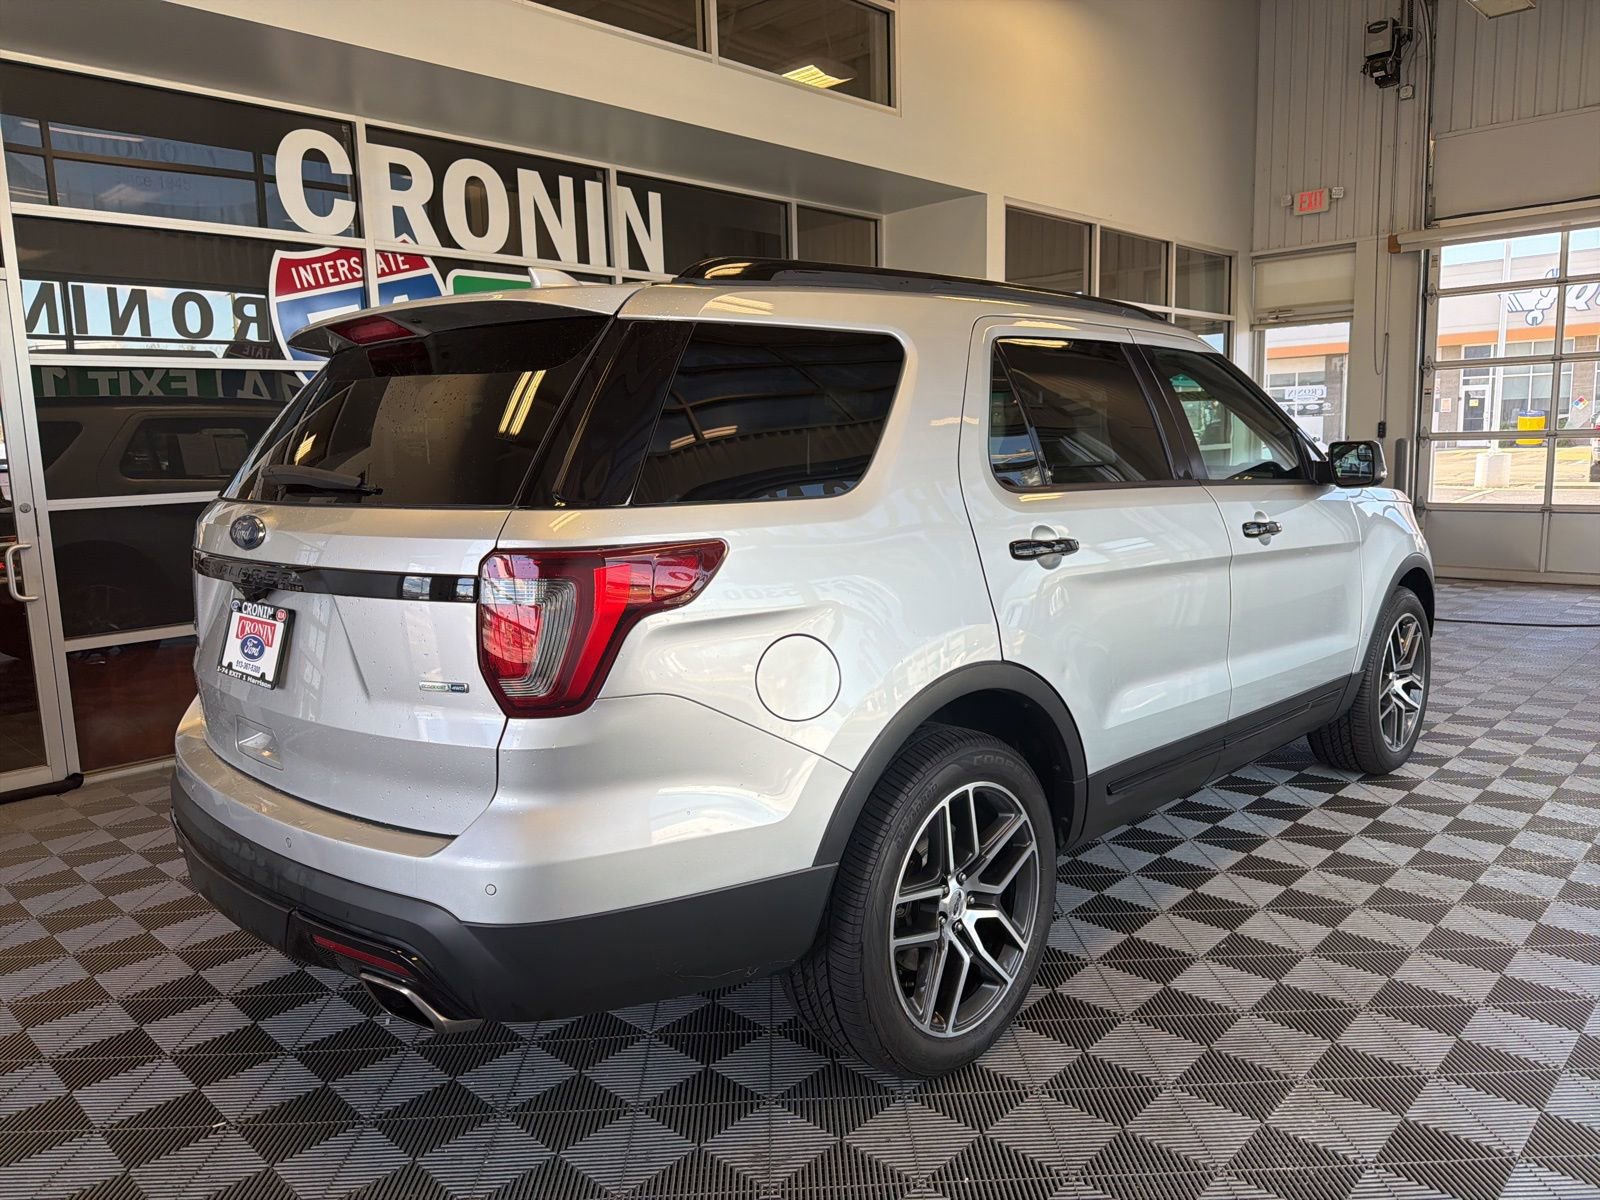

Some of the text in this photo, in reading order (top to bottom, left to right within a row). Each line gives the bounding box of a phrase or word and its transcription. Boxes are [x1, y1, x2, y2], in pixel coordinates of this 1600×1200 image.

[275, 128, 665, 275] CRONIN
[1298, 190, 1324, 212] EXIT
[291, 253, 410, 289] INTERSATE
[242, 601, 274, 620] CRONIN
[238, 619, 275, 648] CRONIN
[243, 638, 261, 657] Ford
[217, 665, 228, 675] I-74
[228, 669, 242, 680] EXIT
[247, 675, 272, 689] Harrison
